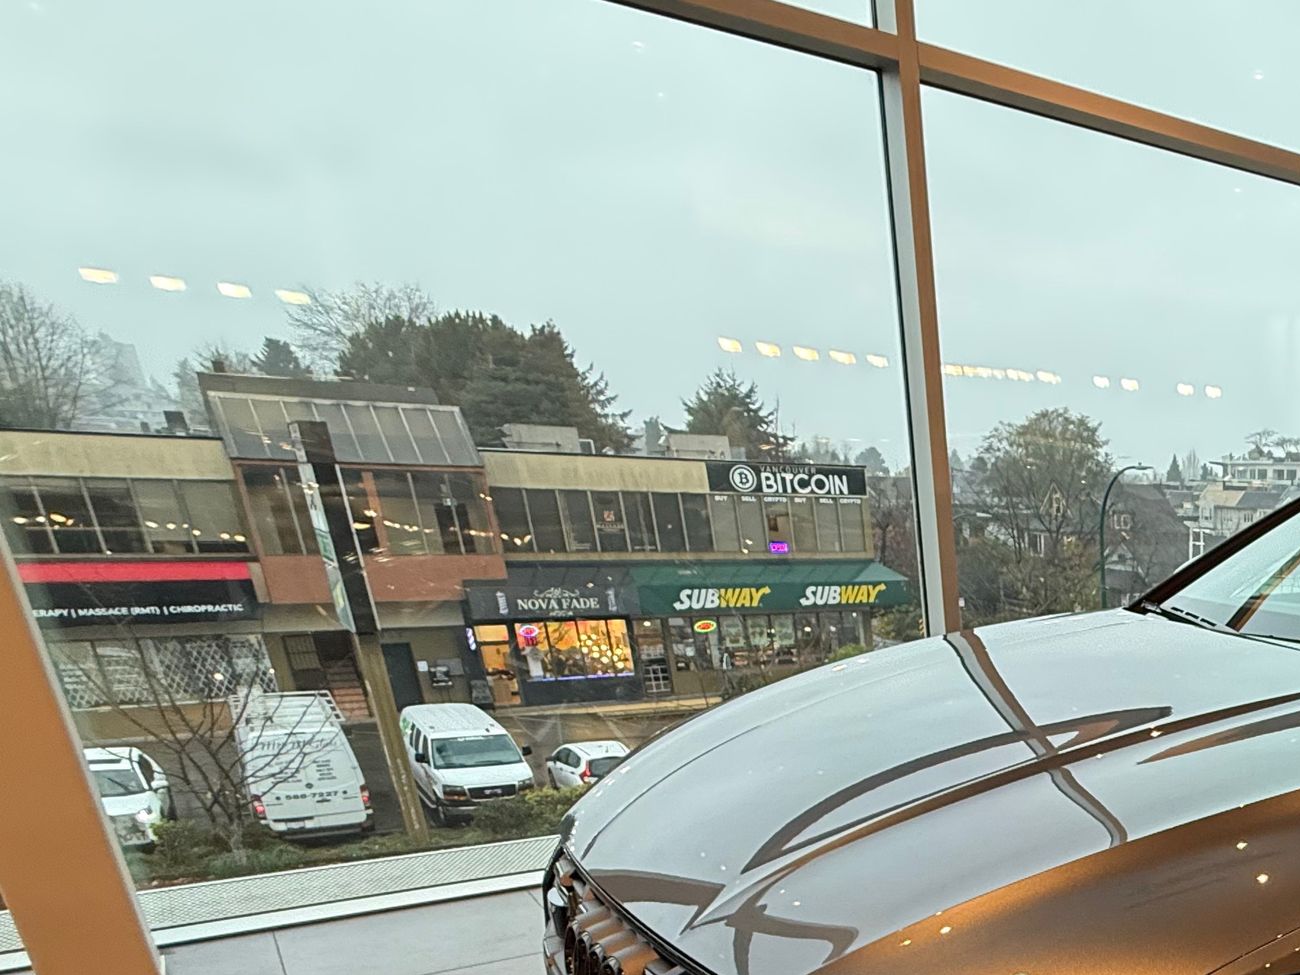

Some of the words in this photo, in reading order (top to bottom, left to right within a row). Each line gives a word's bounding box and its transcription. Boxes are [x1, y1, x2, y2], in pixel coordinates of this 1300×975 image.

[759, 464, 817, 475] VANCOUVER
[760, 471, 849, 495] BITCOIN
[673, 585, 772, 610] SUBWAY
[799, 582, 887, 606] SUBWAY
[168, 603, 244, 615] CHIROPRACTIC
[516, 598, 559, 611] NOVA
[562, 597, 600, 610] FADE
